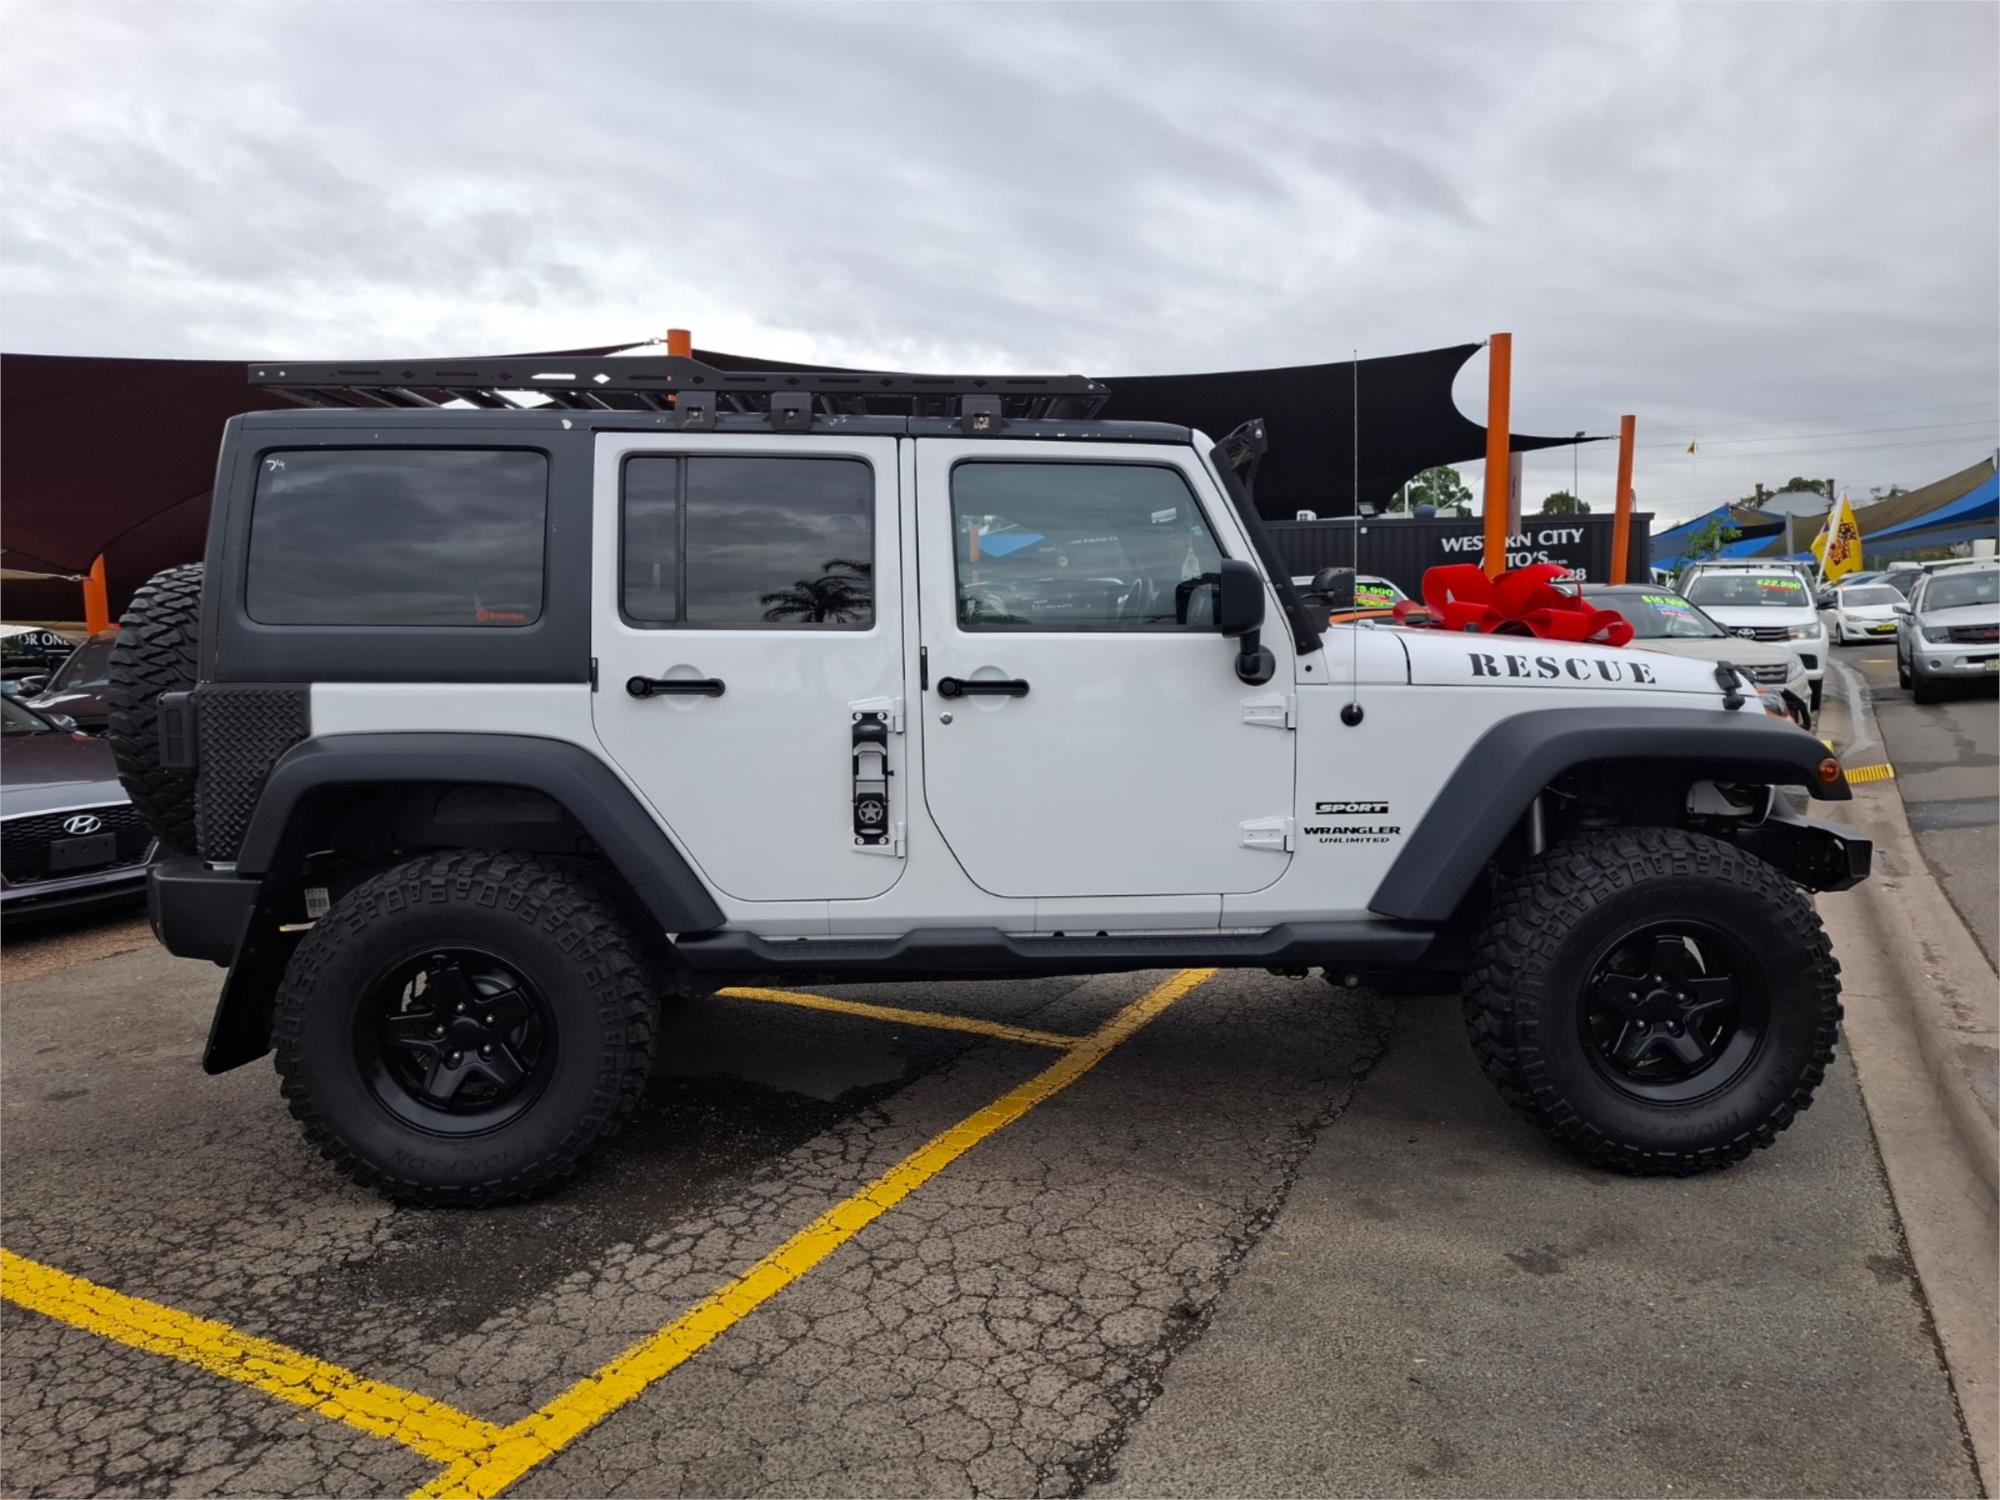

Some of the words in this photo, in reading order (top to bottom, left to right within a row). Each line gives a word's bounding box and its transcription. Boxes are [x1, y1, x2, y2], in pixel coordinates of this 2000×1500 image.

[1441, 532, 1532, 552] WESRN
[1538, 528, 1585, 546] CITY
[1478, 550, 1549, 569] TO'S
[1467, 653, 1656, 684] RESCUE
[1317, 802, 1388, 814] SPORT
[1303, 827, 1401, 835] WRANGLER
